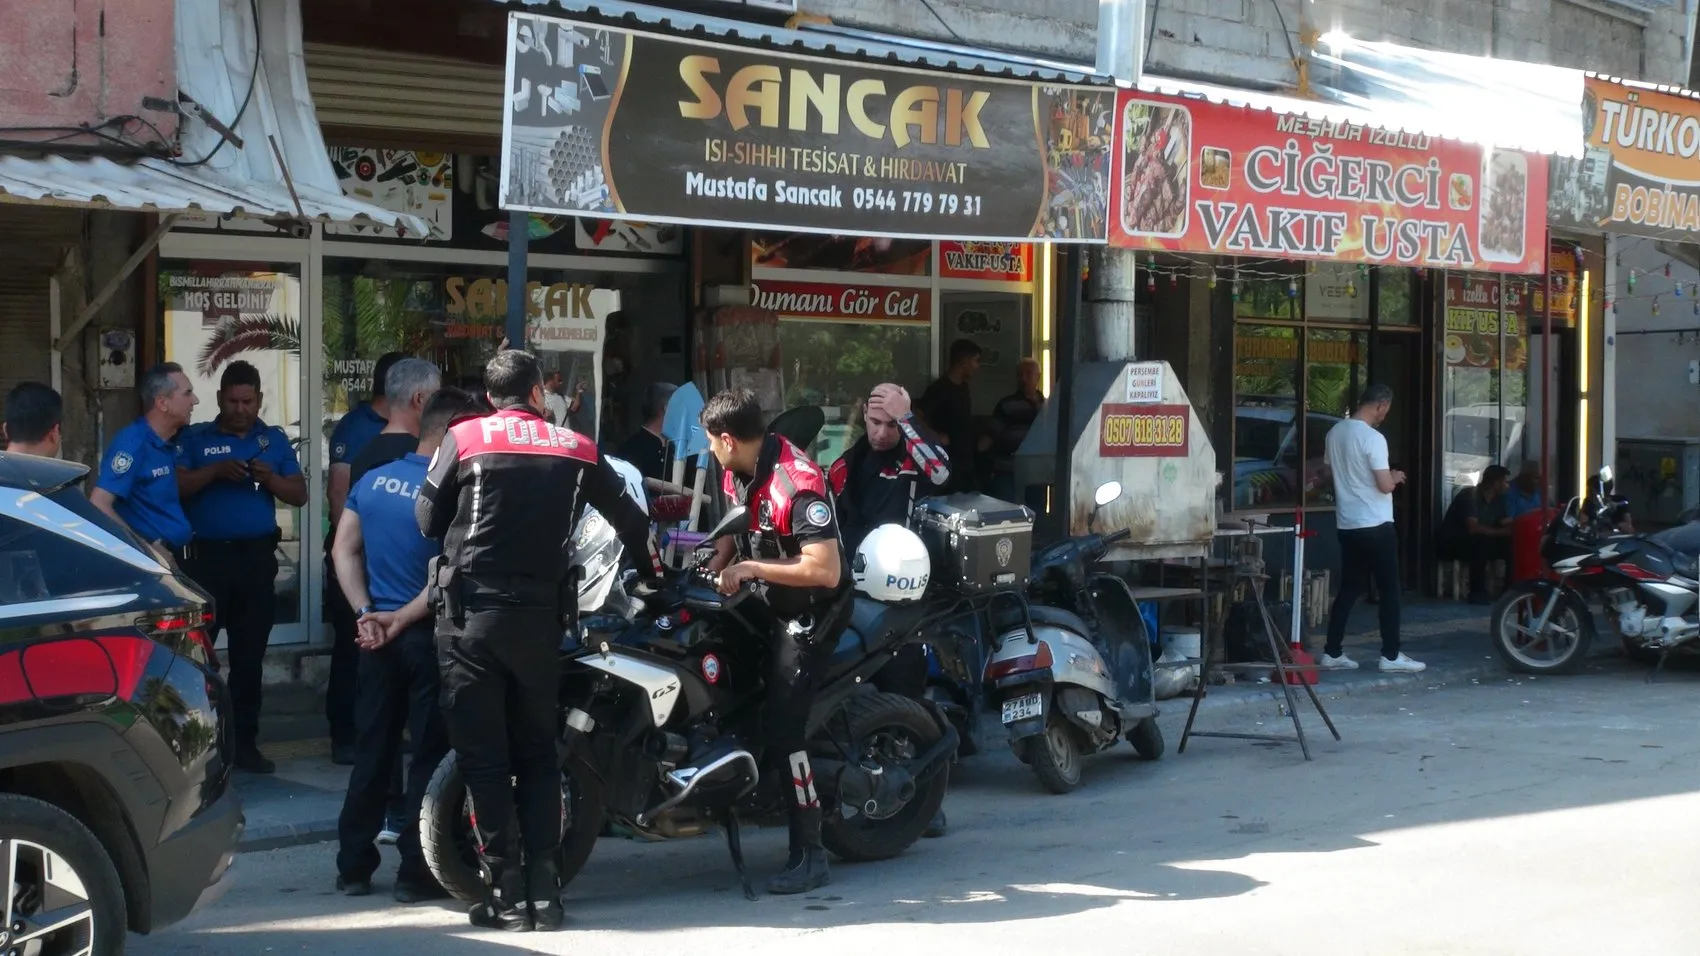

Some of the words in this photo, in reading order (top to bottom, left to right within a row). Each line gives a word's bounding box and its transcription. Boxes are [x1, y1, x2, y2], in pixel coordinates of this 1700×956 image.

[678, 55, 991, 149] SANCAK
[1601, 91, 1700, 160] TÜRKO
[791, 145, 860, 175] TESİSAT
[863, 157, 876, 178] &
[881, 158, 967, 184] HIRDAVAT
[1244, 138, 1442, 210] CİĞERCİ
[685, 171, 767, 201] Mustafa
[775, 180, 842, 208] Sancak
[853, 187, 896, 211] 0544
[902, 191, 932, 214] 779
[939, 194, 957, 215] 79
[963, 196, 982, 216] 31
[1611, 183, 1700, 231] BOBİNA
[1195, 200, 1347, 256] VAKIF
[1361, 216, 1475, 265] USTA
[945, 250, 988, 271] VAKIF
[990, 253, 1026, 275] USTA
[184, 291, 210, 311] HOŞ
[840, 289, 879, 314] Gör
[884, 291, 919, 316] Gel
[1477, 308, 1519, 336] USA
[341, 378, 366, 391] 0544
[1105, 414, 1133, 446] 0507
[1133, 414, 1154, 446] 818
[1154, 415, 1167, 446] 31
[1167, 415, 1184, 446] 28
[652, 681, 677, 699] GS
